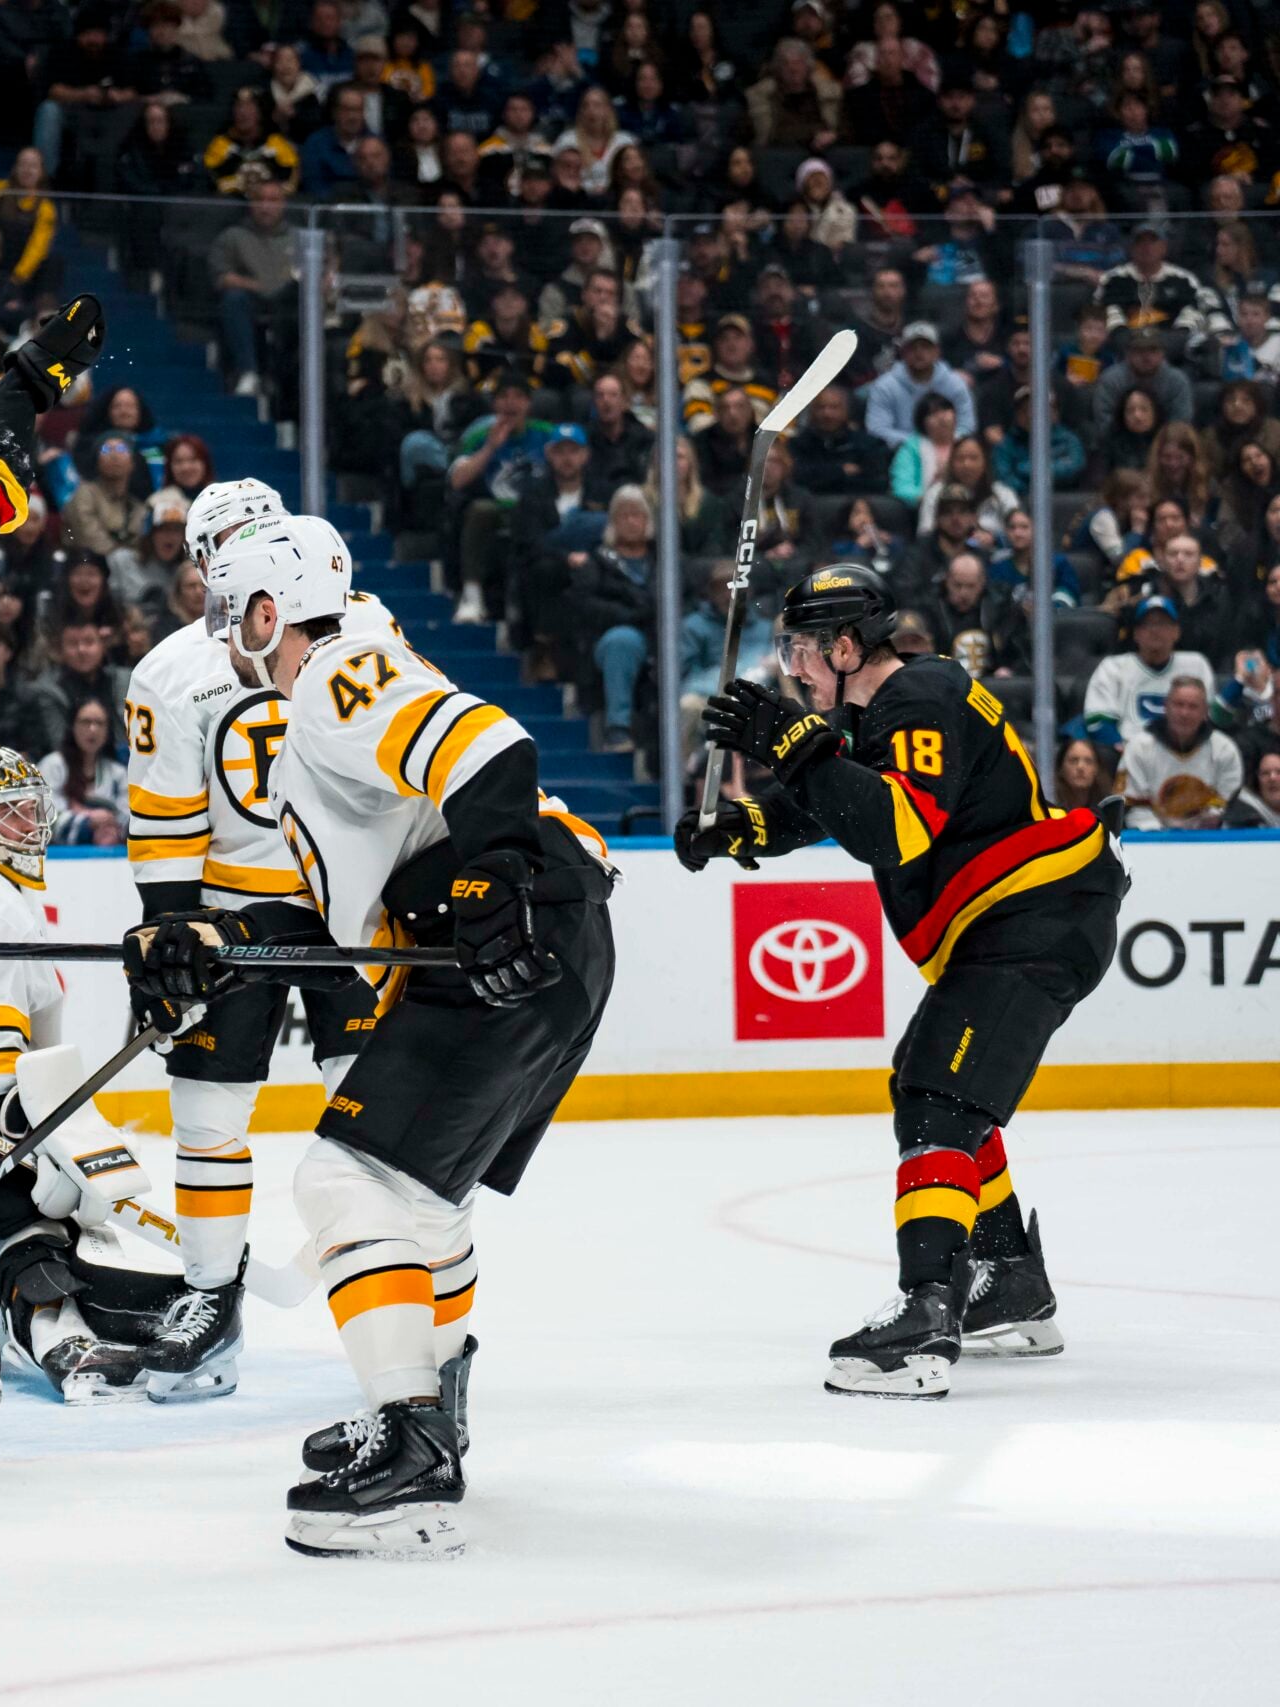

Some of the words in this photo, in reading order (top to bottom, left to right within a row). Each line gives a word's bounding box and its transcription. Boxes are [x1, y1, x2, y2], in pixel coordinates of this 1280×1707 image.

[331, 556, 344, 573] 47
[727, 519, 758, 599] CCM
[813, 577, 852, 592] NexGen
[327, 651, 401, 722] 47
[890, 727, 944, 778] 18
[231, 946, 309, 958] BAUER
[950, 1026, 974, 1073] BAUER
[84, 1153, 131, 1170] TRUE
